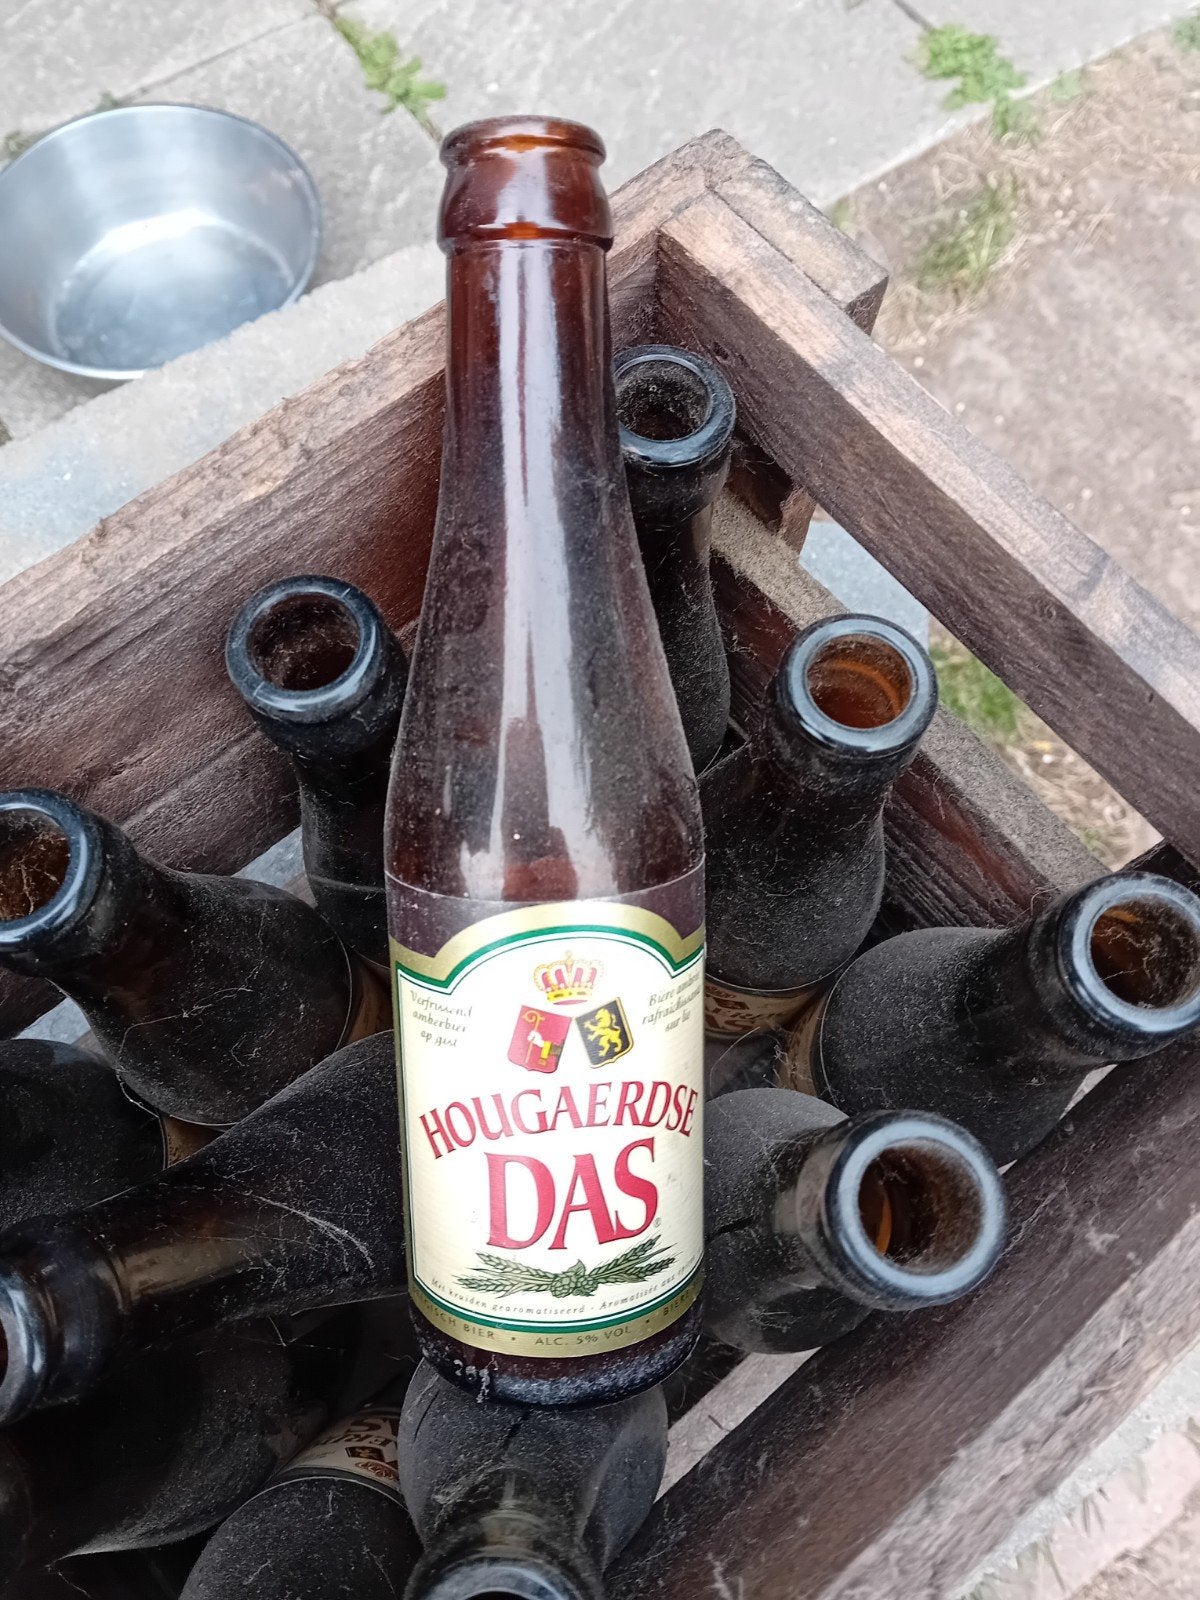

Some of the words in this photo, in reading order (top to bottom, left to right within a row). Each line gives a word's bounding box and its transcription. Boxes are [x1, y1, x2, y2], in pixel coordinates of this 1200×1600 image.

[418, 1080, 699, 1160] HOUGAERDSE
[484, 1137, 659, 1250] DAS
[463, 1323, 495, 1340] BIER
[576, 1335, 599, 1346] 5%
